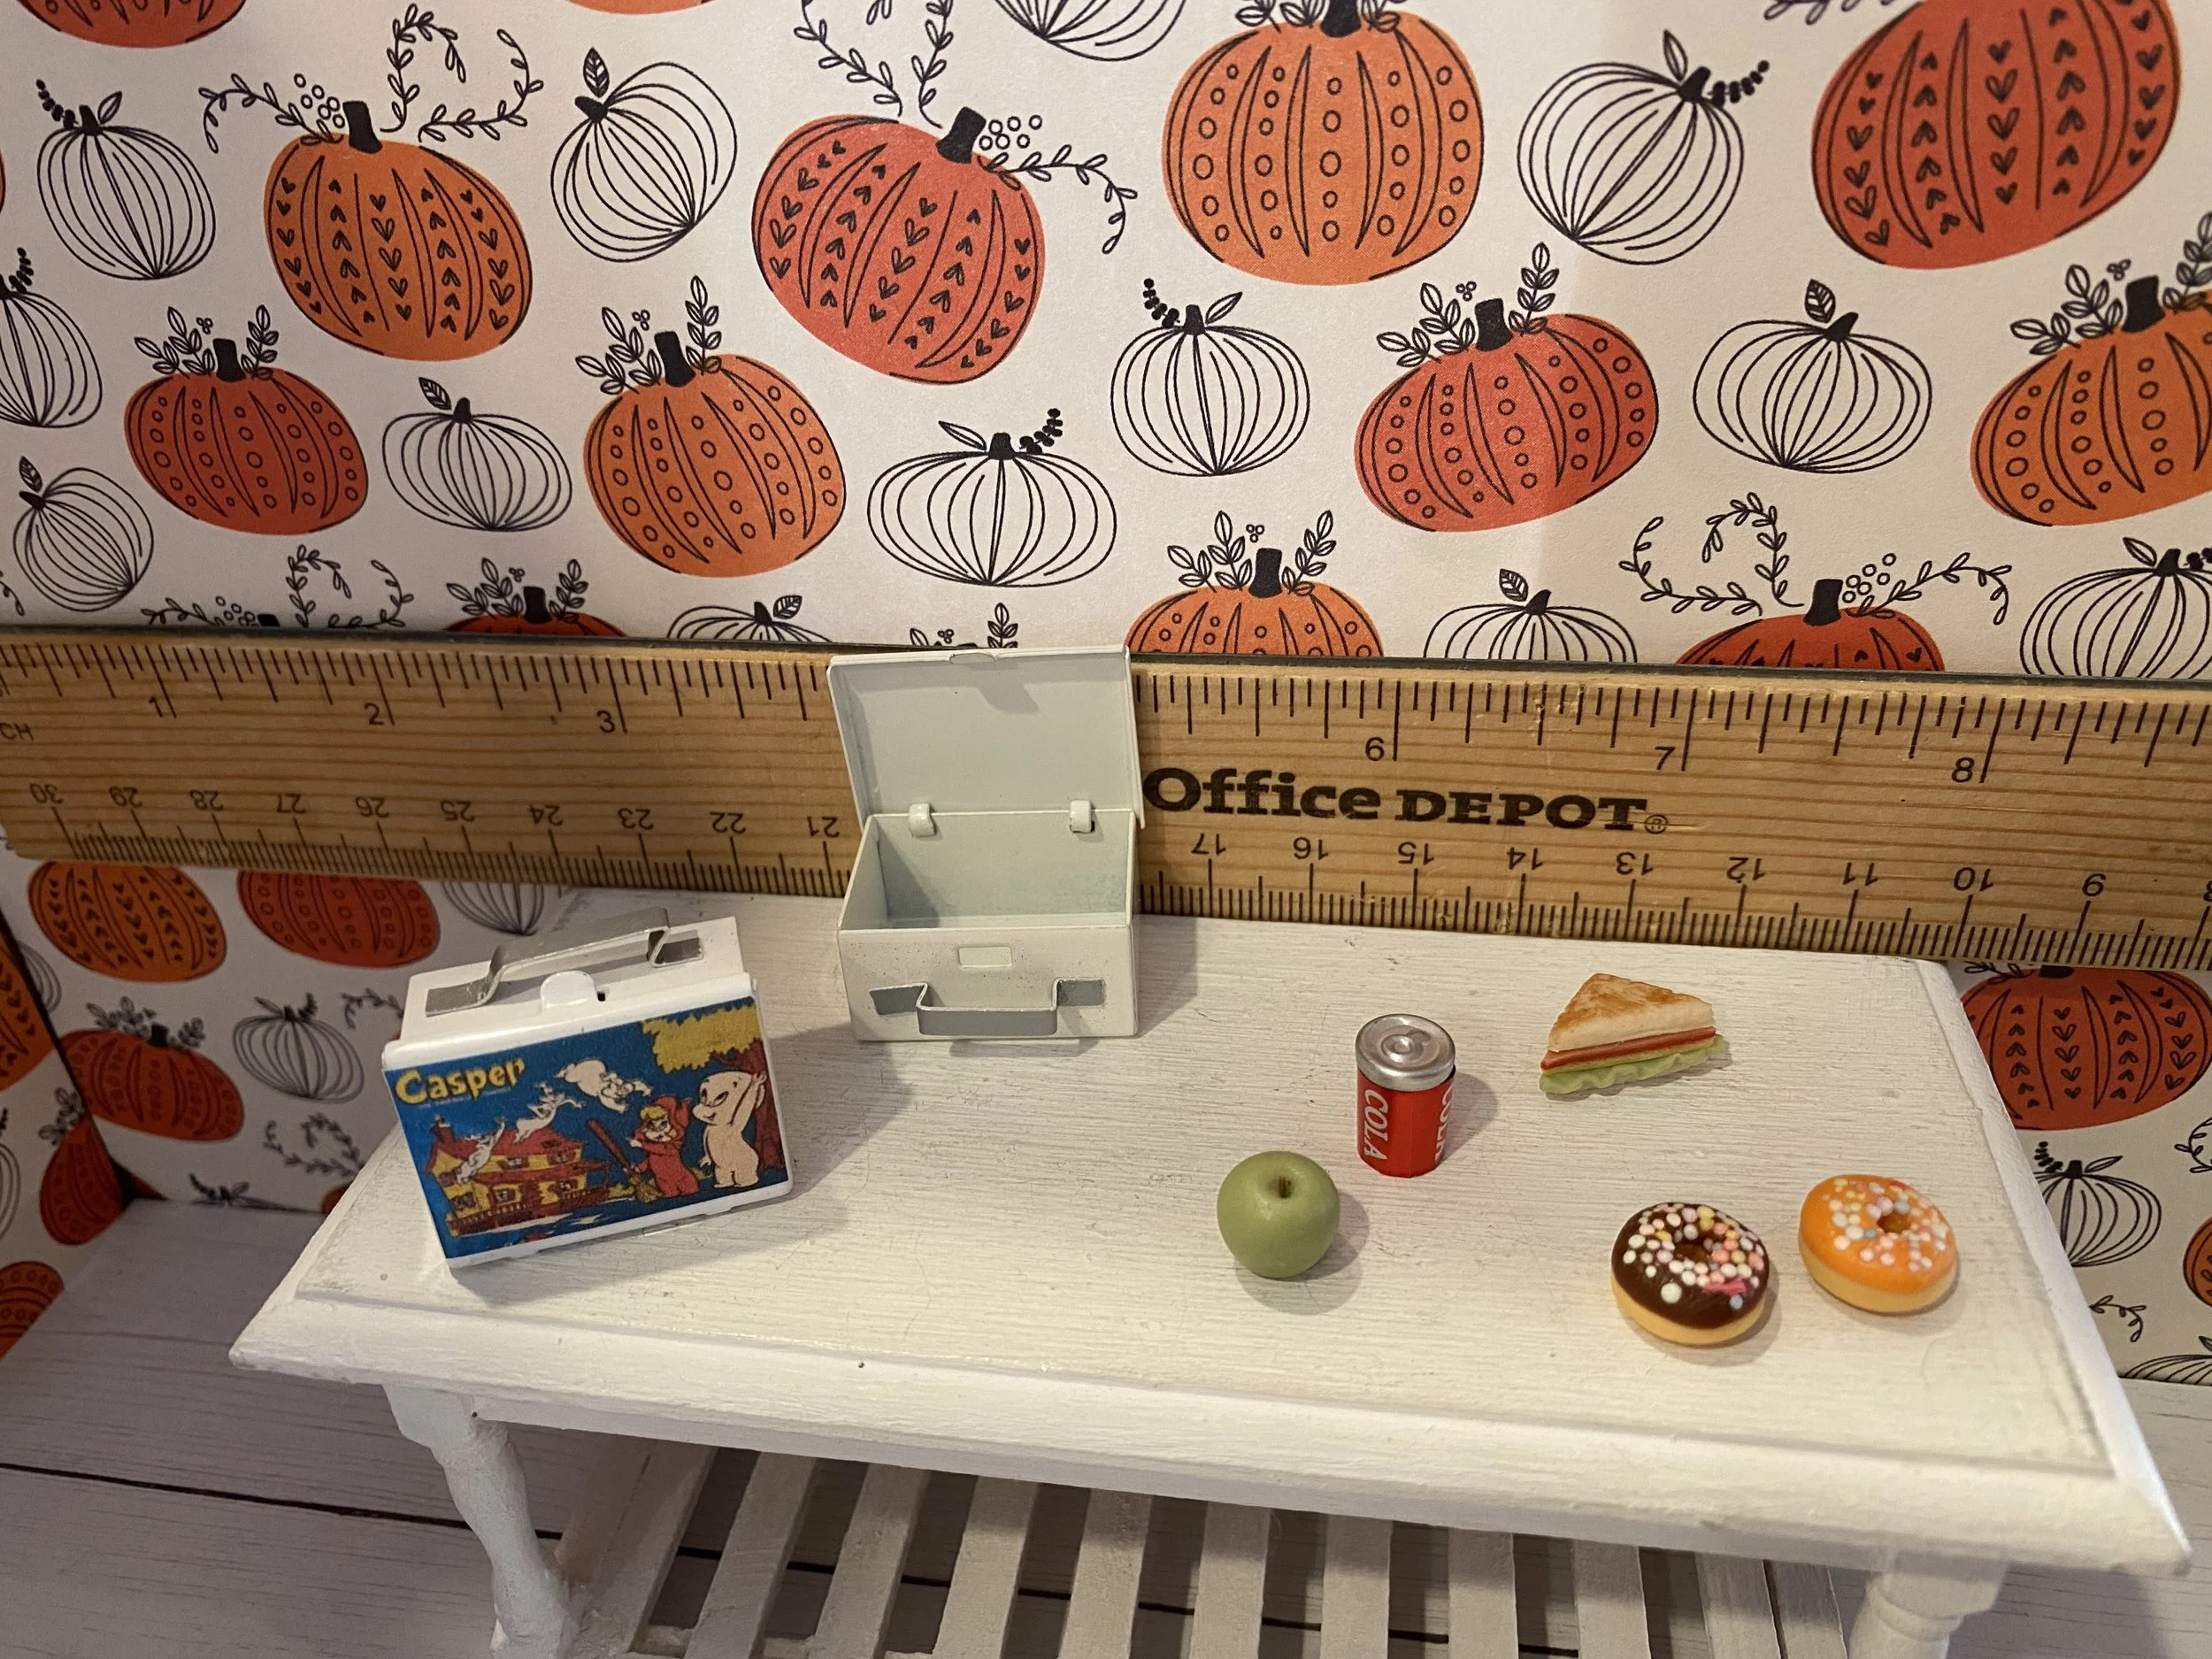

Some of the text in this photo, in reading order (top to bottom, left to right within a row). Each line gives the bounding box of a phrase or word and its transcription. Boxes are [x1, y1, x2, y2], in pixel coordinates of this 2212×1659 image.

[148, 695, 1976, 783] 1 2 3 6 7 8
[29, 782, 64, 805] 30
[108, 785, 142, 809] 29
[189, 788, 224, 812] 28
[275, 792, 307, 816] 27
[1141, 766, 1382, 820] Office
[356, 796, 390, 818] 26
[440, 800, 477, 822] 25
[528, 804, 564, 826] 24
[618, 807, 655, 831] 23
[709, 810, 747, 834] 22
[806, 815, 841, 839] 21
[1190, 833, 1227, 856] 17
[1292, 836, 1329, 860] 16
[1397, 841, 1435, 865] 15
[1506, 847, 1544, 872] 14
[1616, 851, 1655, 876] 13
[1725, 856, 1767, 882] 12
[1842, 862, 1879, 887] 11
[1953, 867, 1994, 893] 10
[396, 1056, 526, 1104] Casper
[1363, 1088, 1389, 1161] COLA
